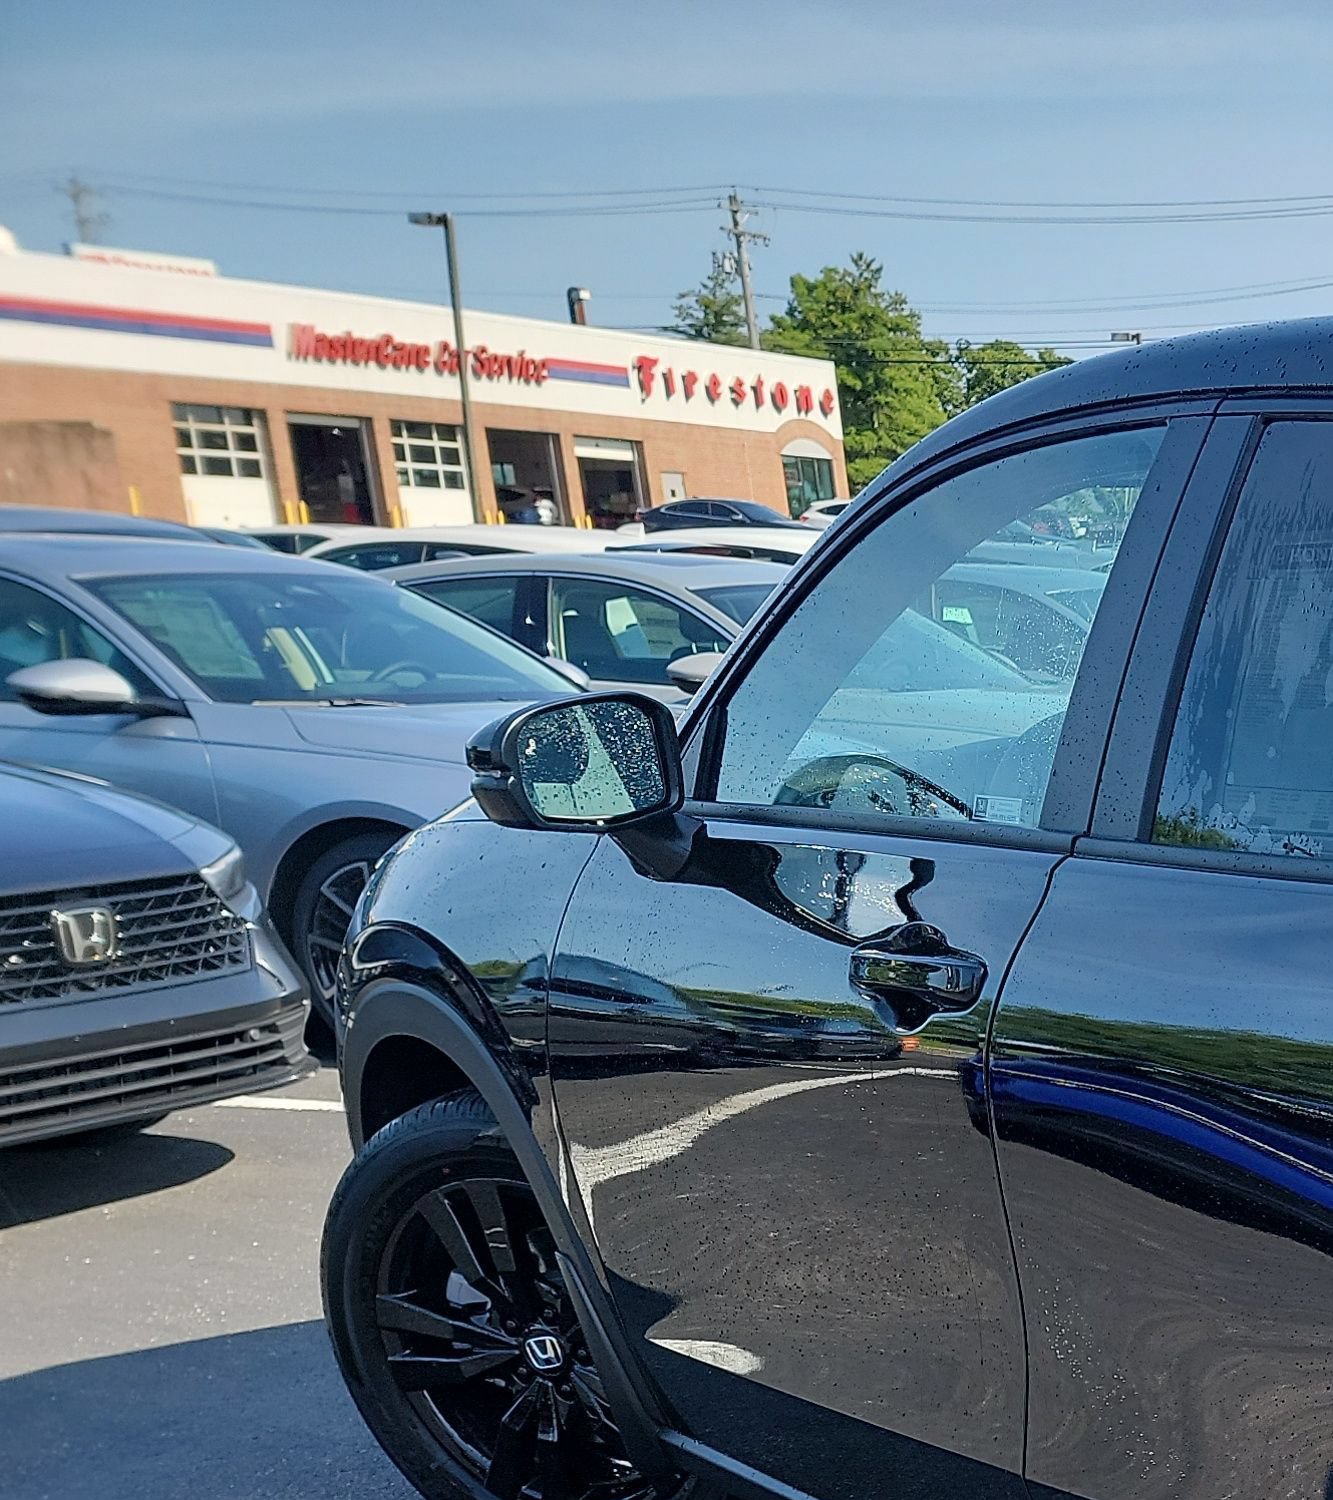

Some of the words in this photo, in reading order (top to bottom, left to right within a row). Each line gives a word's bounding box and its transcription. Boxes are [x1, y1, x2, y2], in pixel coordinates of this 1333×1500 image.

[290, 323, 431, 369] MasterCare
[472, 343, 548, 384] Service
[634, 355, 835, 416] Firestone
